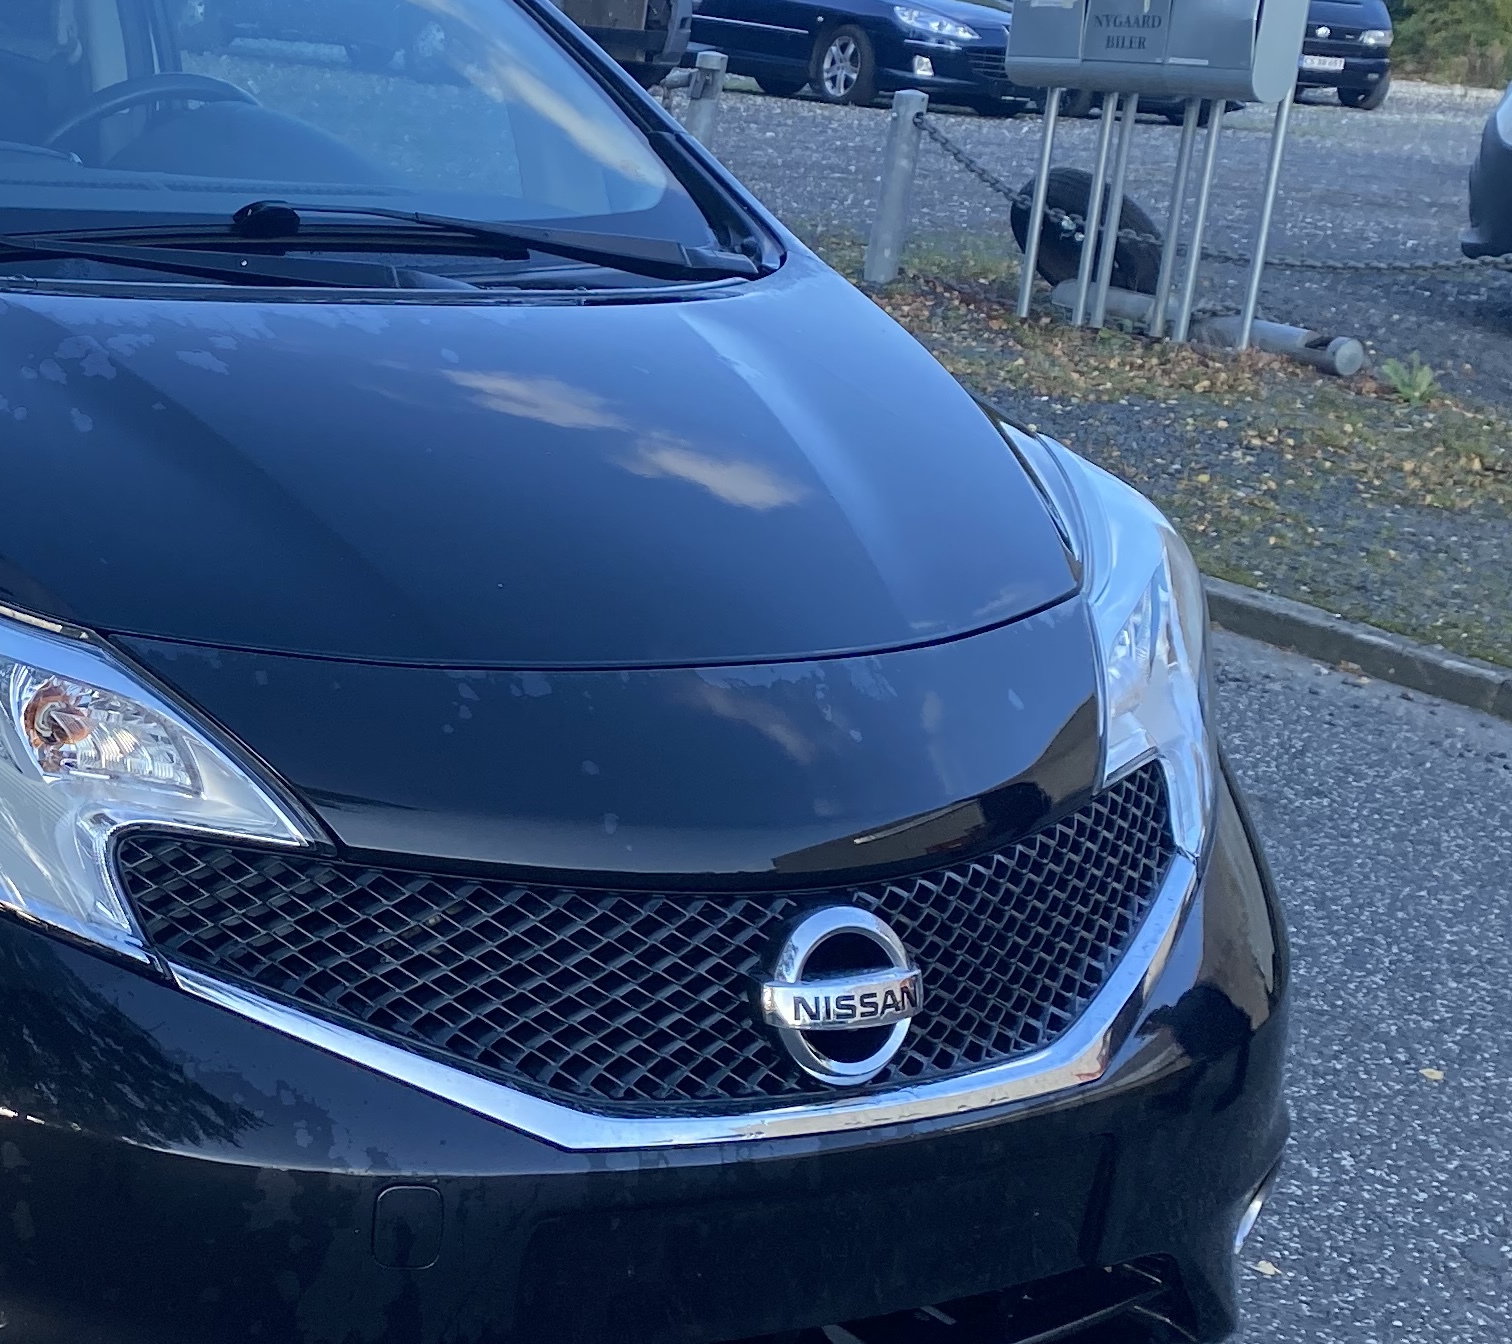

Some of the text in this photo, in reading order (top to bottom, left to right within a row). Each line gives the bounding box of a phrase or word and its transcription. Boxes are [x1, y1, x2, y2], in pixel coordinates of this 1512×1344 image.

[1093, 14, 1162, 29] NYGAARD
[1106, 35, 1146, 49] BILER
[793, 985, 917, 1021] NISSAN
